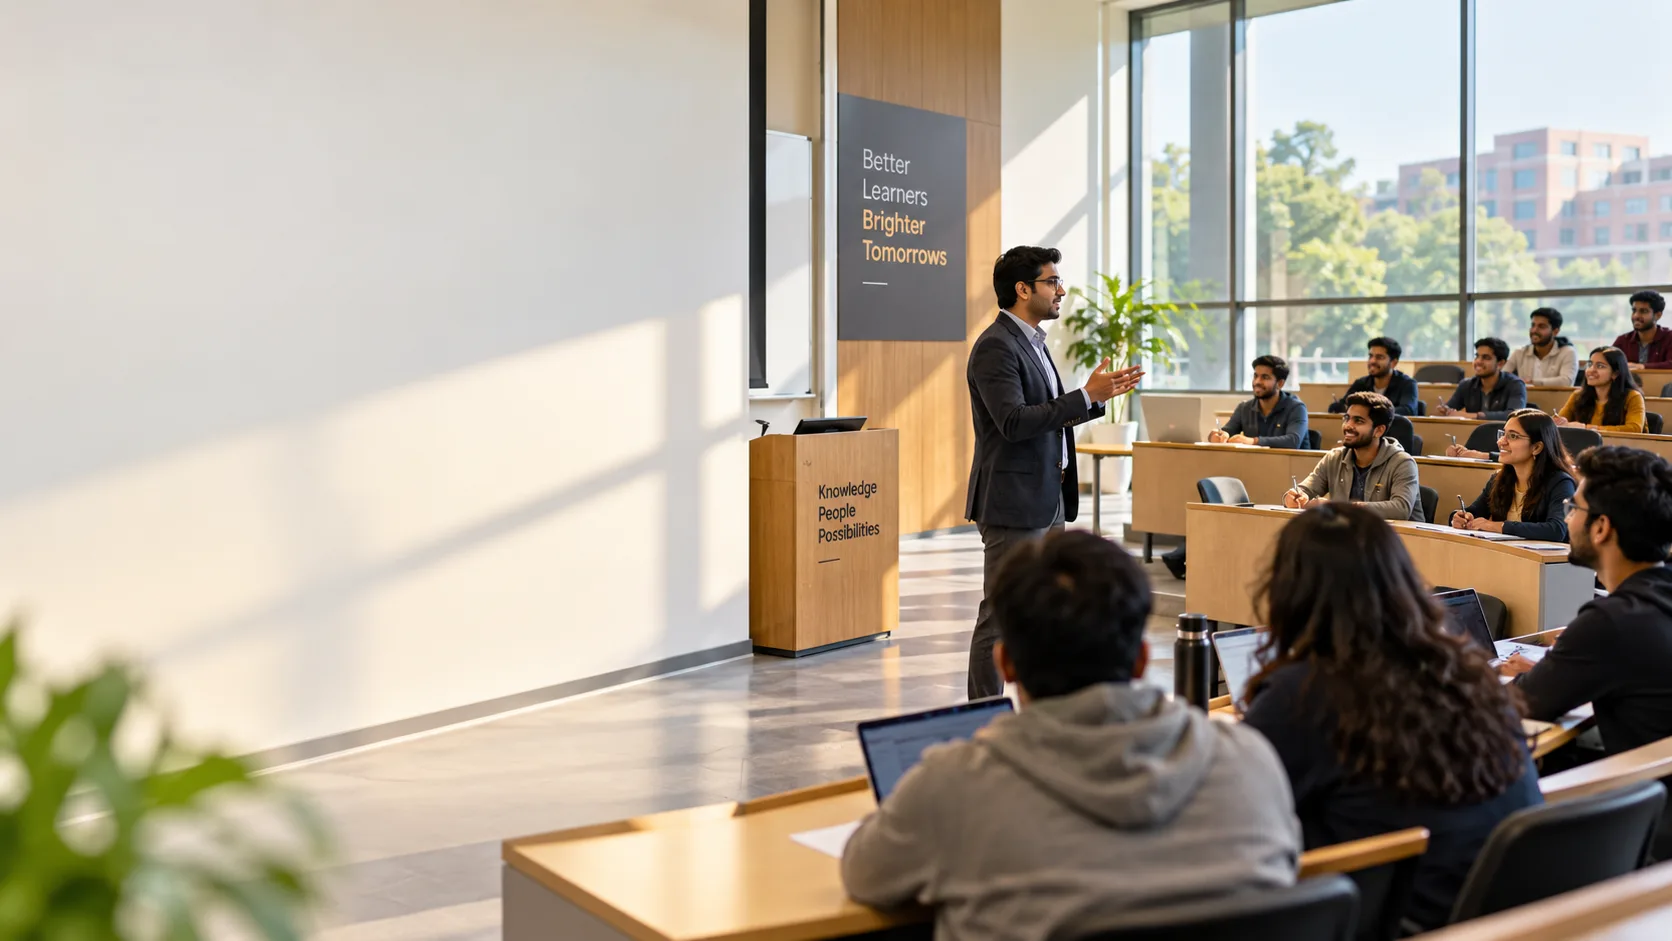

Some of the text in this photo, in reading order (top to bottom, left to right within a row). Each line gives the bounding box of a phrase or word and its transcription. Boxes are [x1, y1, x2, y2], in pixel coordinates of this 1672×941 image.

[863, 148, 910, 175] Better
[863, 178, 928, 206] Learners
[862, 209, 926, 237] Brighter
[862, 239, 947, 266] Tomorrows
[818, 480, 877, 499] Knowledge
[818, 503, 856, 522] People
[818, 521, 880, 544] Possibilities
